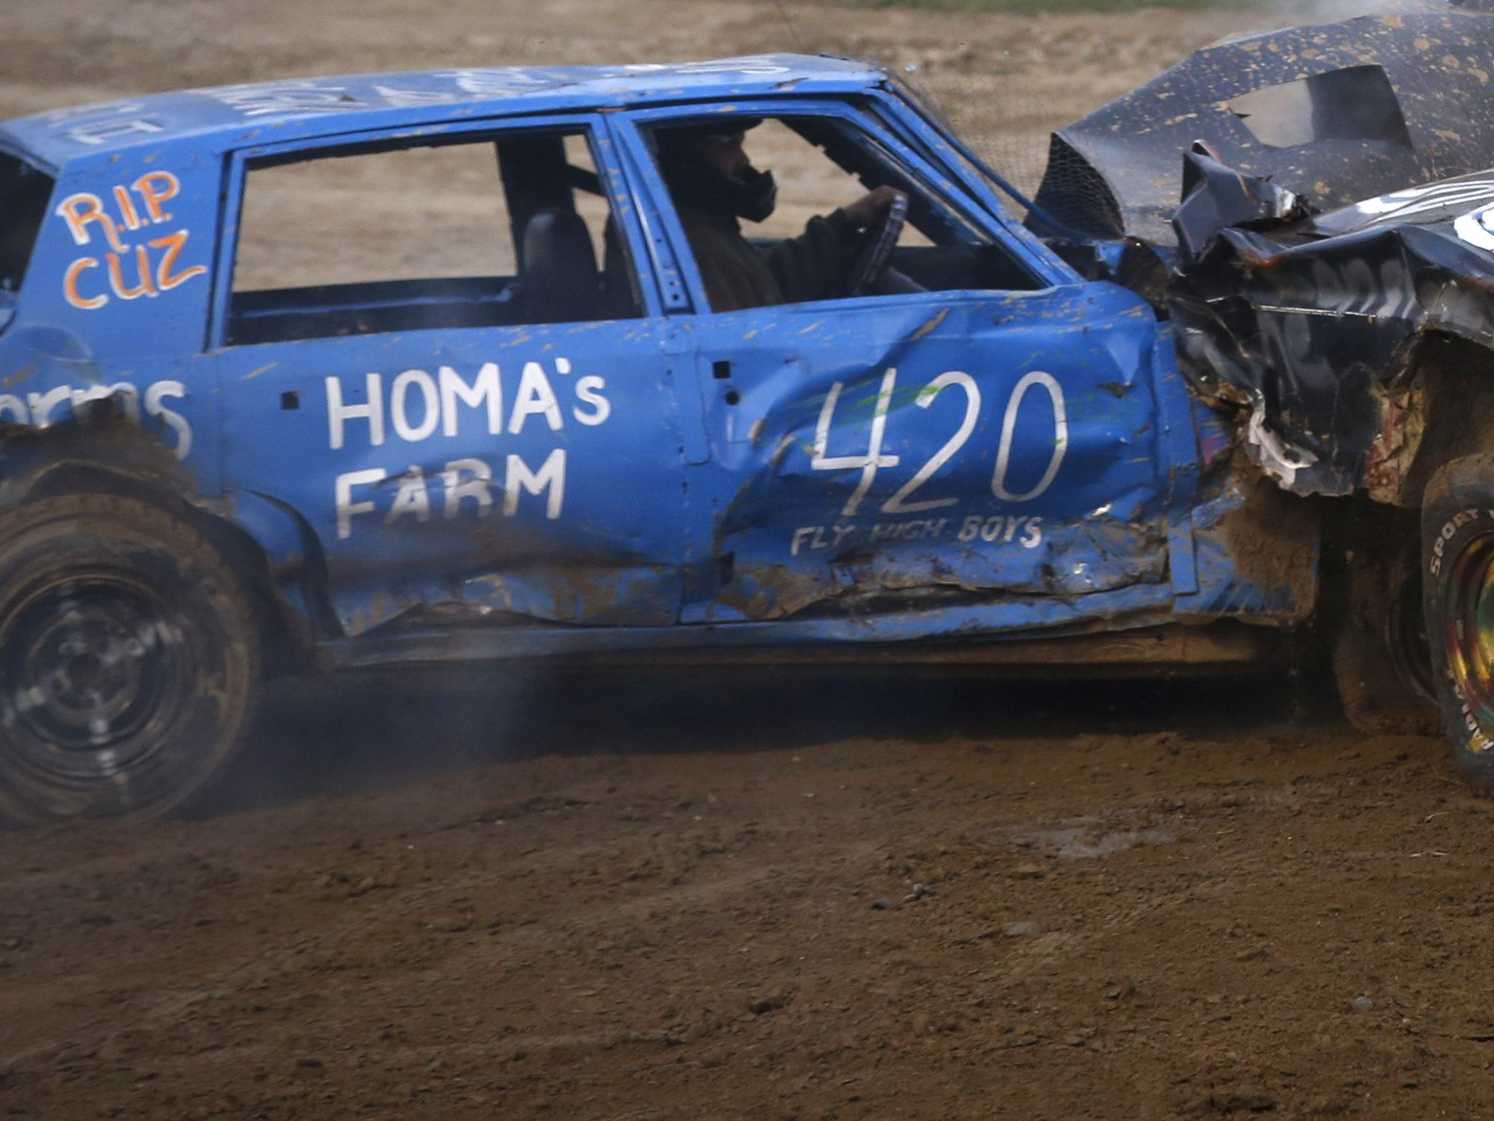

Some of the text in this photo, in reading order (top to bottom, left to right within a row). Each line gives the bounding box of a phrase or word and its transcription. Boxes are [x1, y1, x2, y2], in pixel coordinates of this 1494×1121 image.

[63, 228, 208, 309] CUZ
[325, 357, 611, 450] HOMA's
[811, 367, 1069, 516] 420
[335, 447, 567, 540] FARM
[790, 523, 856, 556] FLY
[957, 515, 1042, 549] BOYS
[1429, 508, 1480, 577] SPORT
